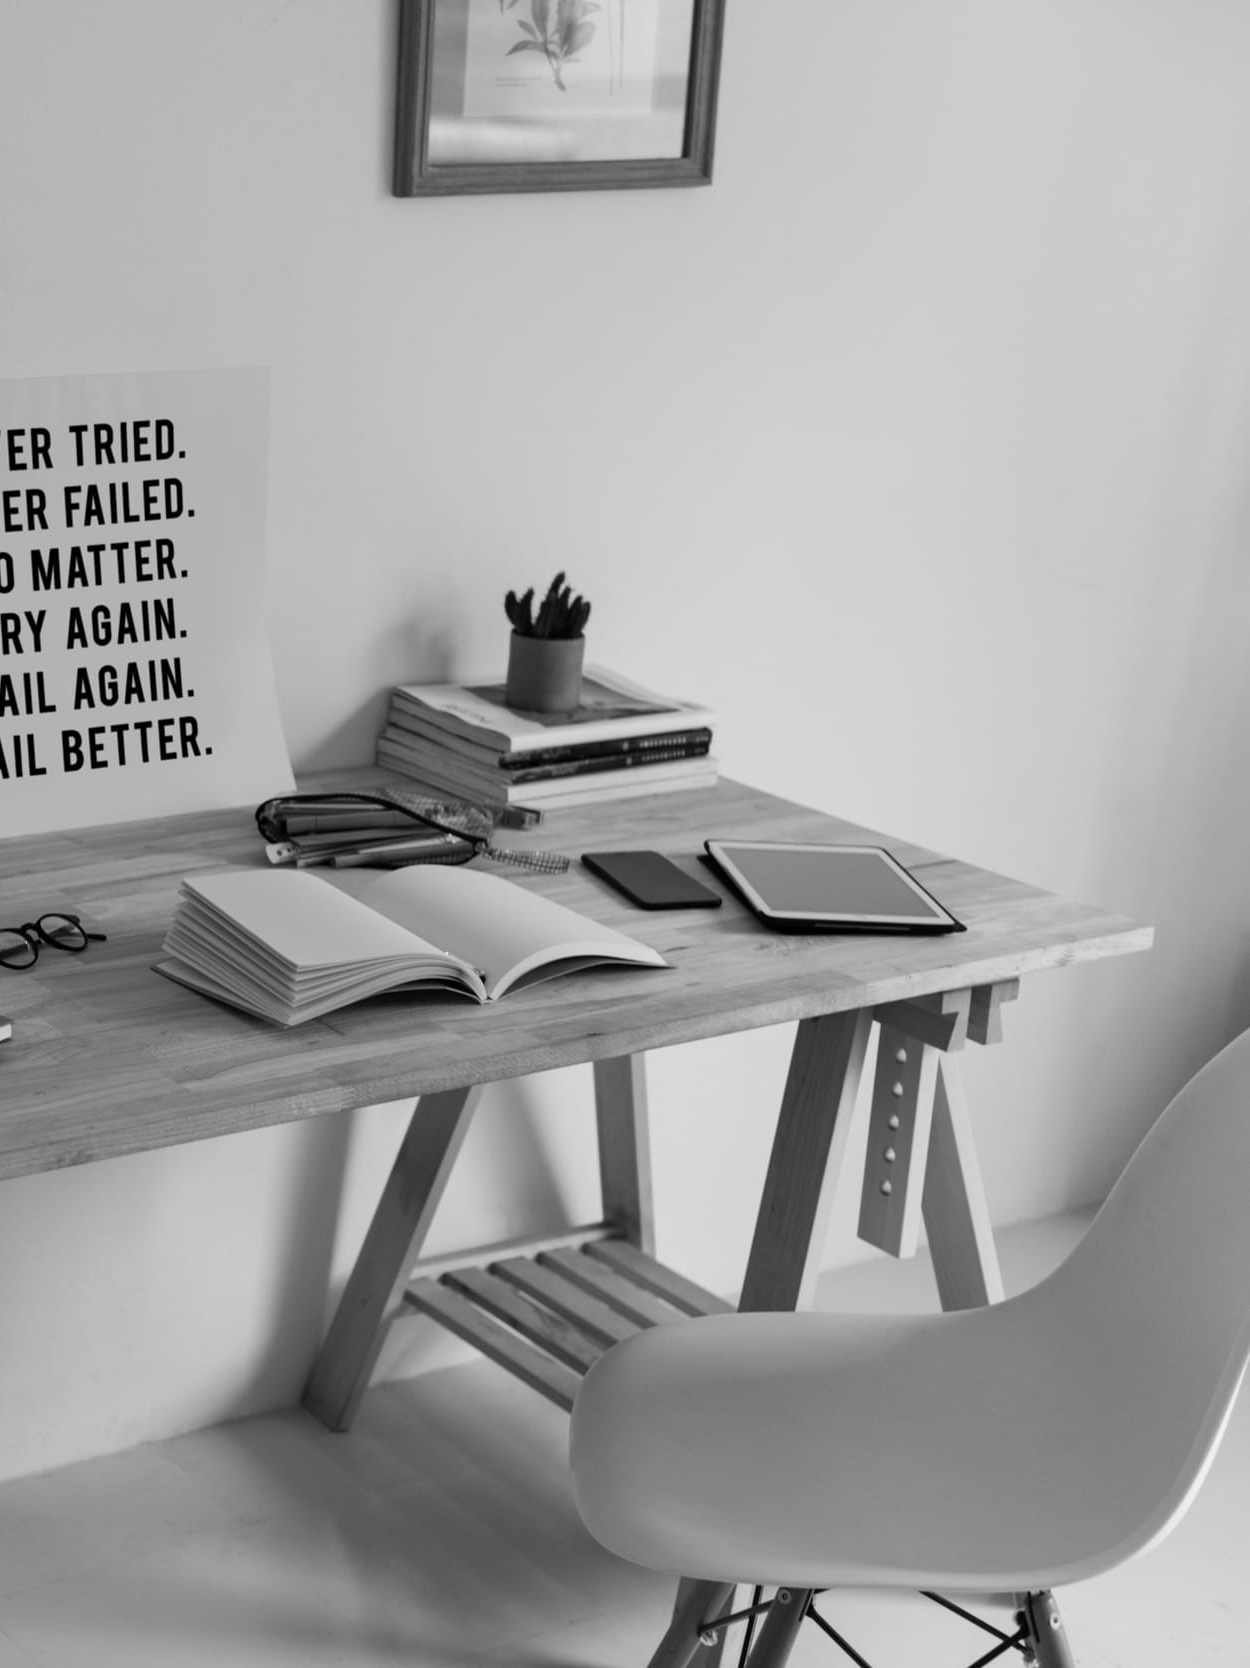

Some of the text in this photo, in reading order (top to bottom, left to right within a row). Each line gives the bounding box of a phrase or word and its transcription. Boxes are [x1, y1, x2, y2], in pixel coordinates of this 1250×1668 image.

[68, 418, 186, 467] TRIED.
[63, 477, 195, 528] FAILED.
[30, 538, 189, 592] MATTER.
[66, 597, 188, 650] AGAIN.
[73, 657, 195, 711] AGAIN.
[61, 715, 213, 773] BETTER.
